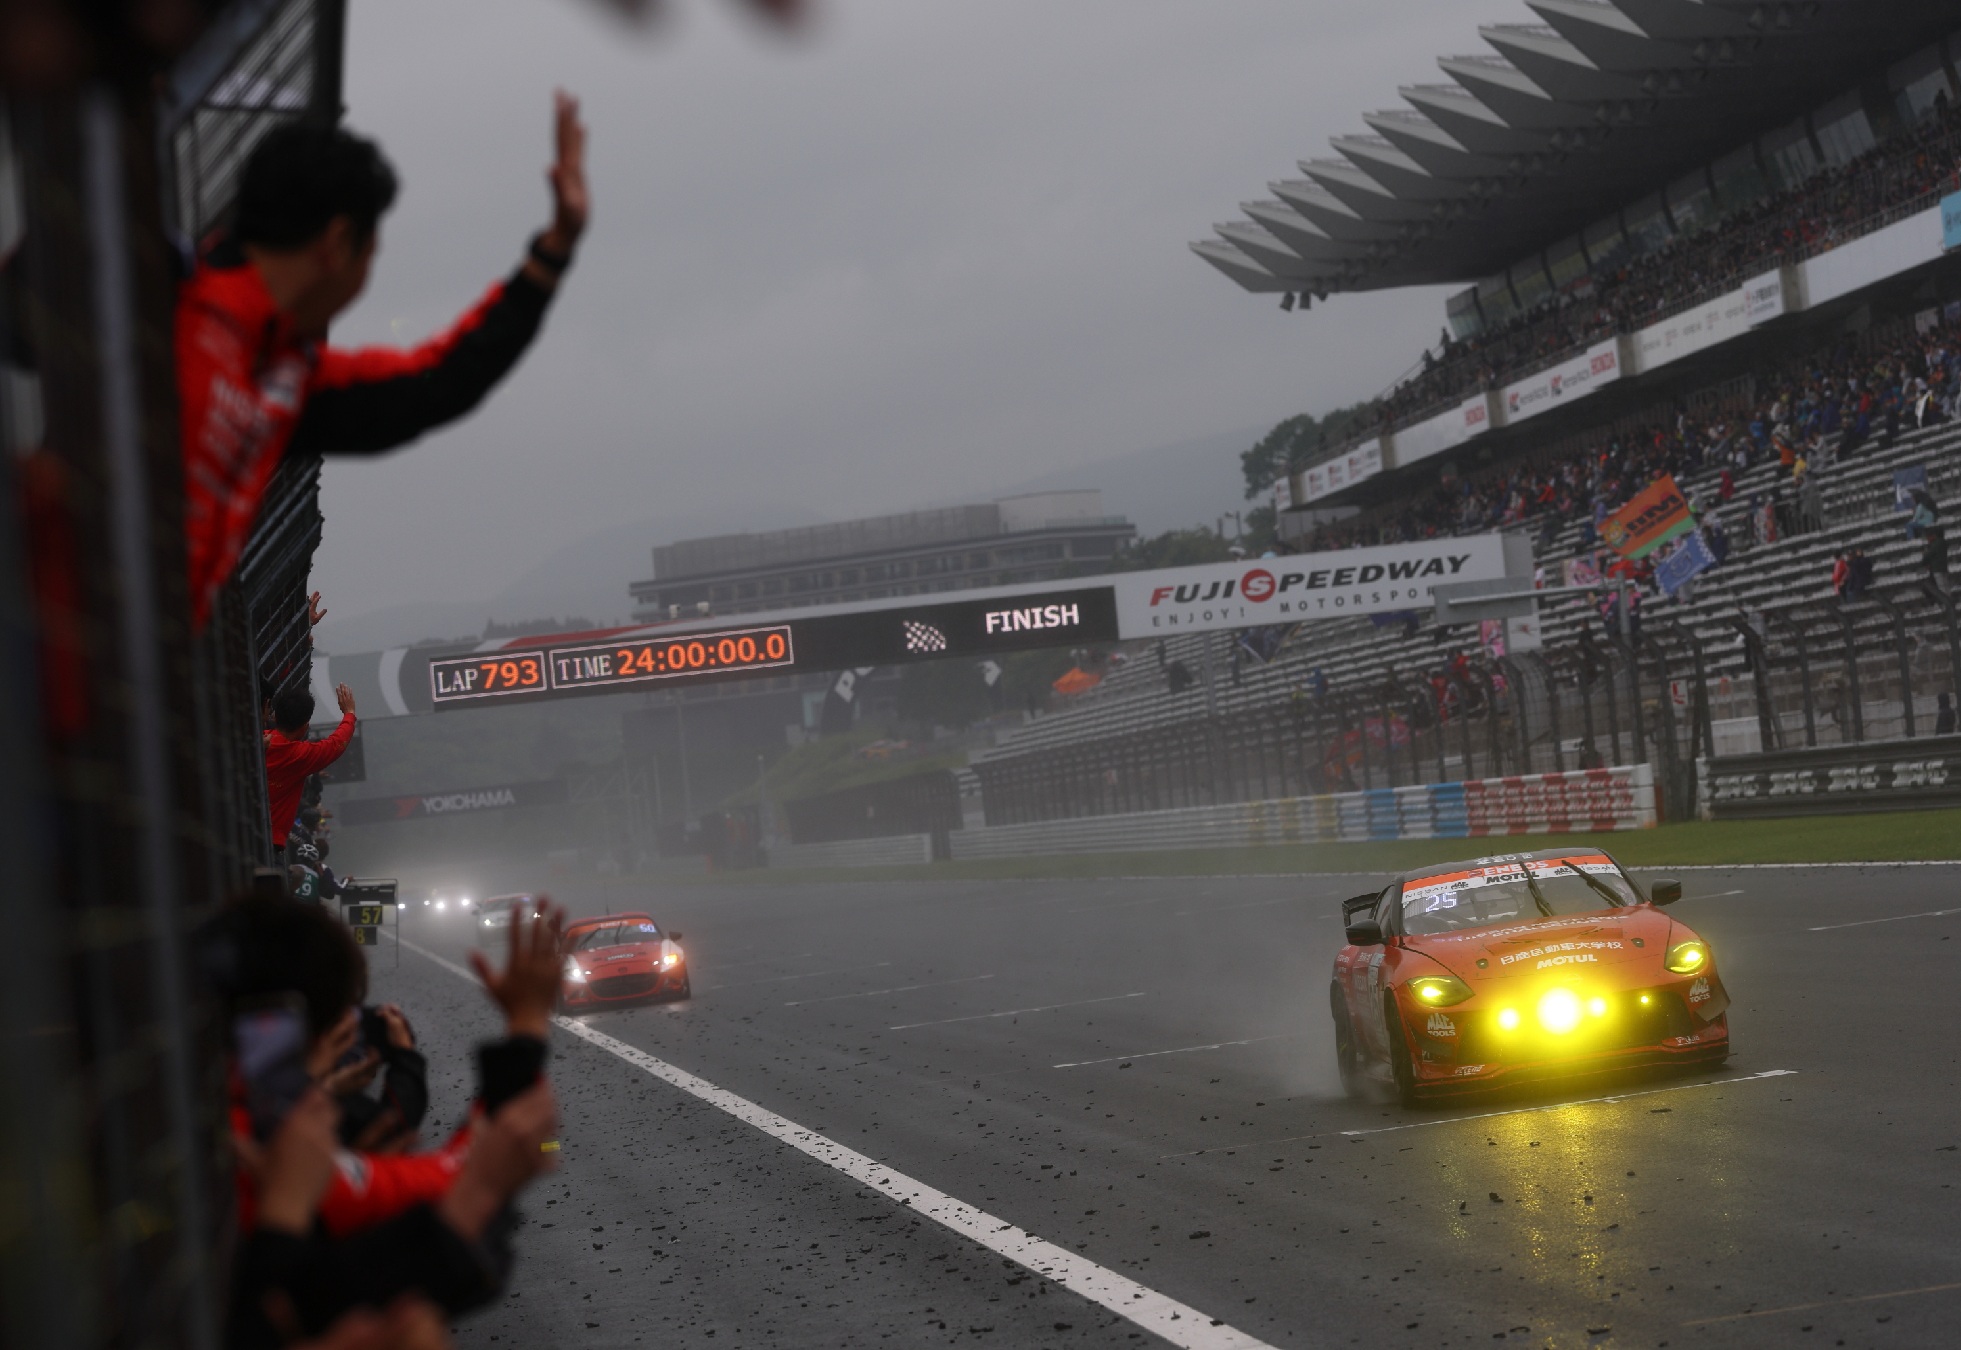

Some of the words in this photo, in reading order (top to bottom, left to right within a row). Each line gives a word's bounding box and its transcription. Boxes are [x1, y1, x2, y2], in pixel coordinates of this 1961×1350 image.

[1149, 580, 1236, 607] FUJI
[1240, 554, 1471, 602] SPEEDWAY
[985, 602, 1080, 635] FINISH
[1152, 606, 1246, 628] ENJOY!
[557, 654, 612, 682] TIME
[617, 633, 786, 676] 24:00:00.0
[437, 668, 479, 694] LAP
[481, 658, 540, 689] 793
[422, 788, 516, 814] YOKOHAMA
[1484, 860, 1549, 876] ENEOS
[1485, 870, 1540, 885] MOTUL
[1424, 892, 1457, 913] 25
[361, 906, 382, 925] 57
[355, 927, 366, 945] 8
[638, 923, 657, 933] 50
[1536, 953, 1598, 970] MOTUL
[1427, 1012, 1456, 1031] MAC
[1427, 1029, 1456, 1037] TOOLS
